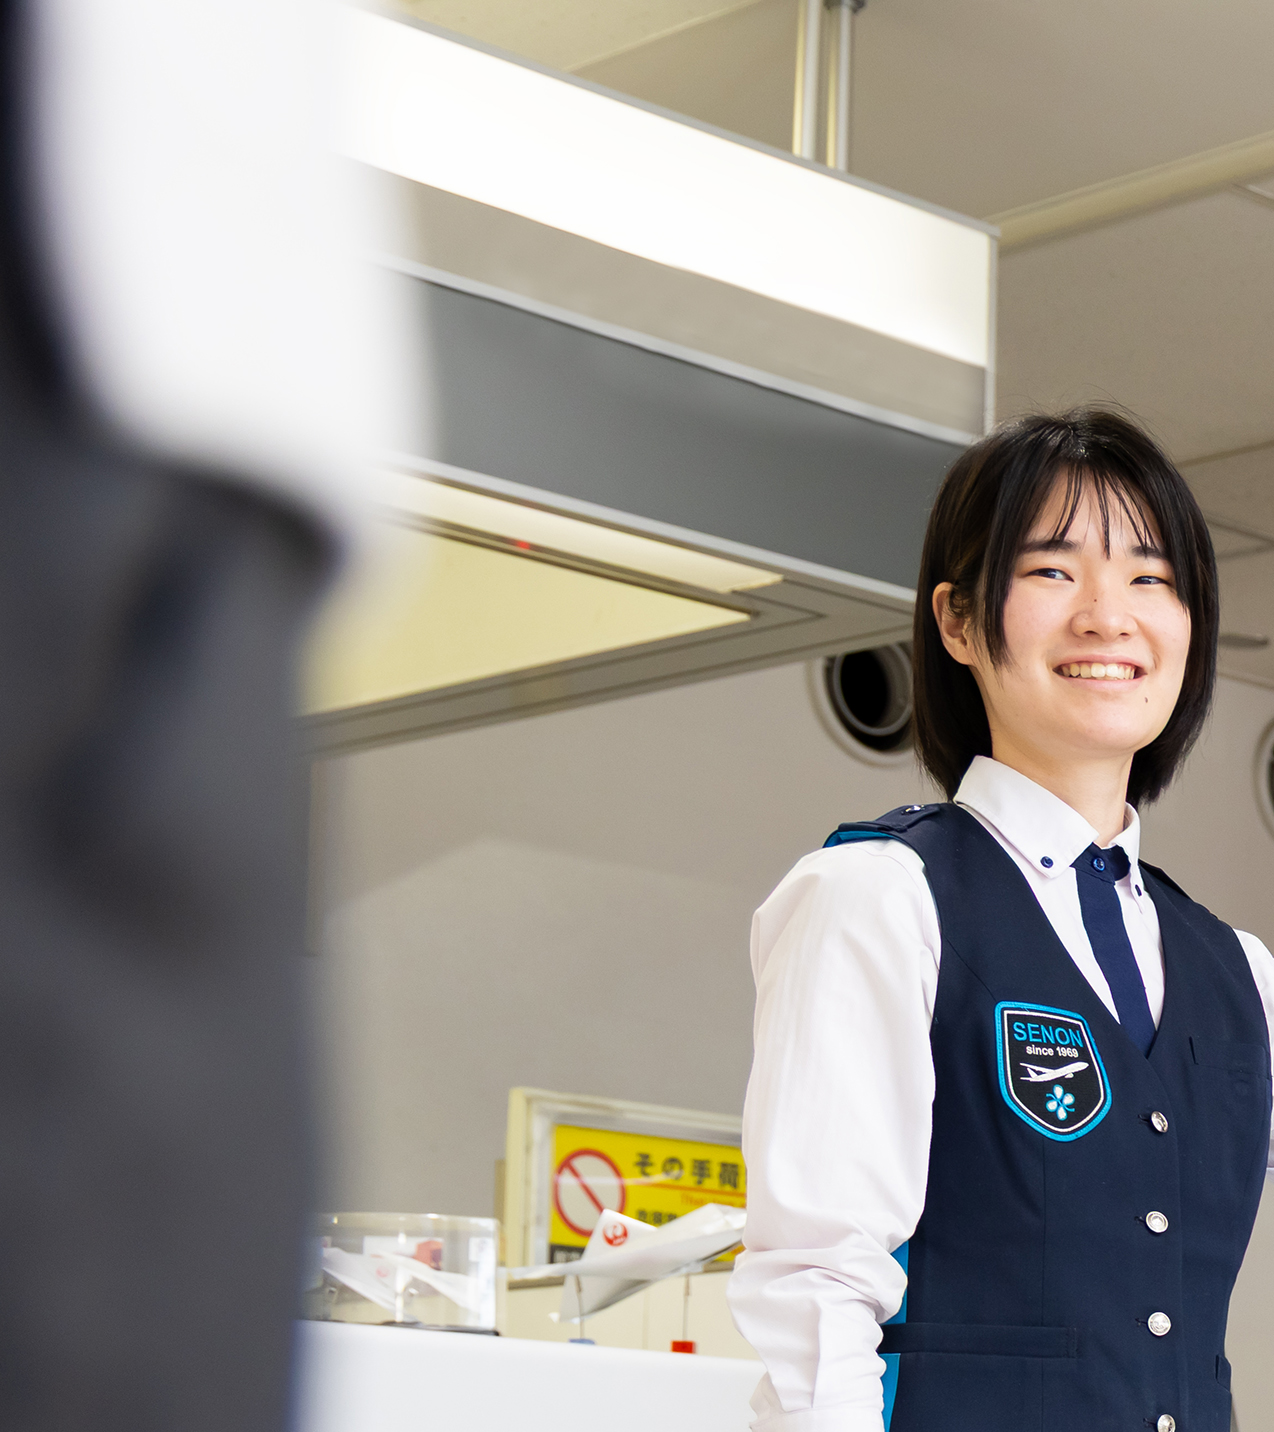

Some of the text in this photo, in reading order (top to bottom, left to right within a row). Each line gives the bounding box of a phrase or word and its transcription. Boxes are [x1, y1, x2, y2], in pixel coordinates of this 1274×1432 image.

[1012, 1021, 1084, 1048] SENON
[1026, 1044, 1079, 1058] since 1969
[634, 1153, 745, 1190] その手荷
